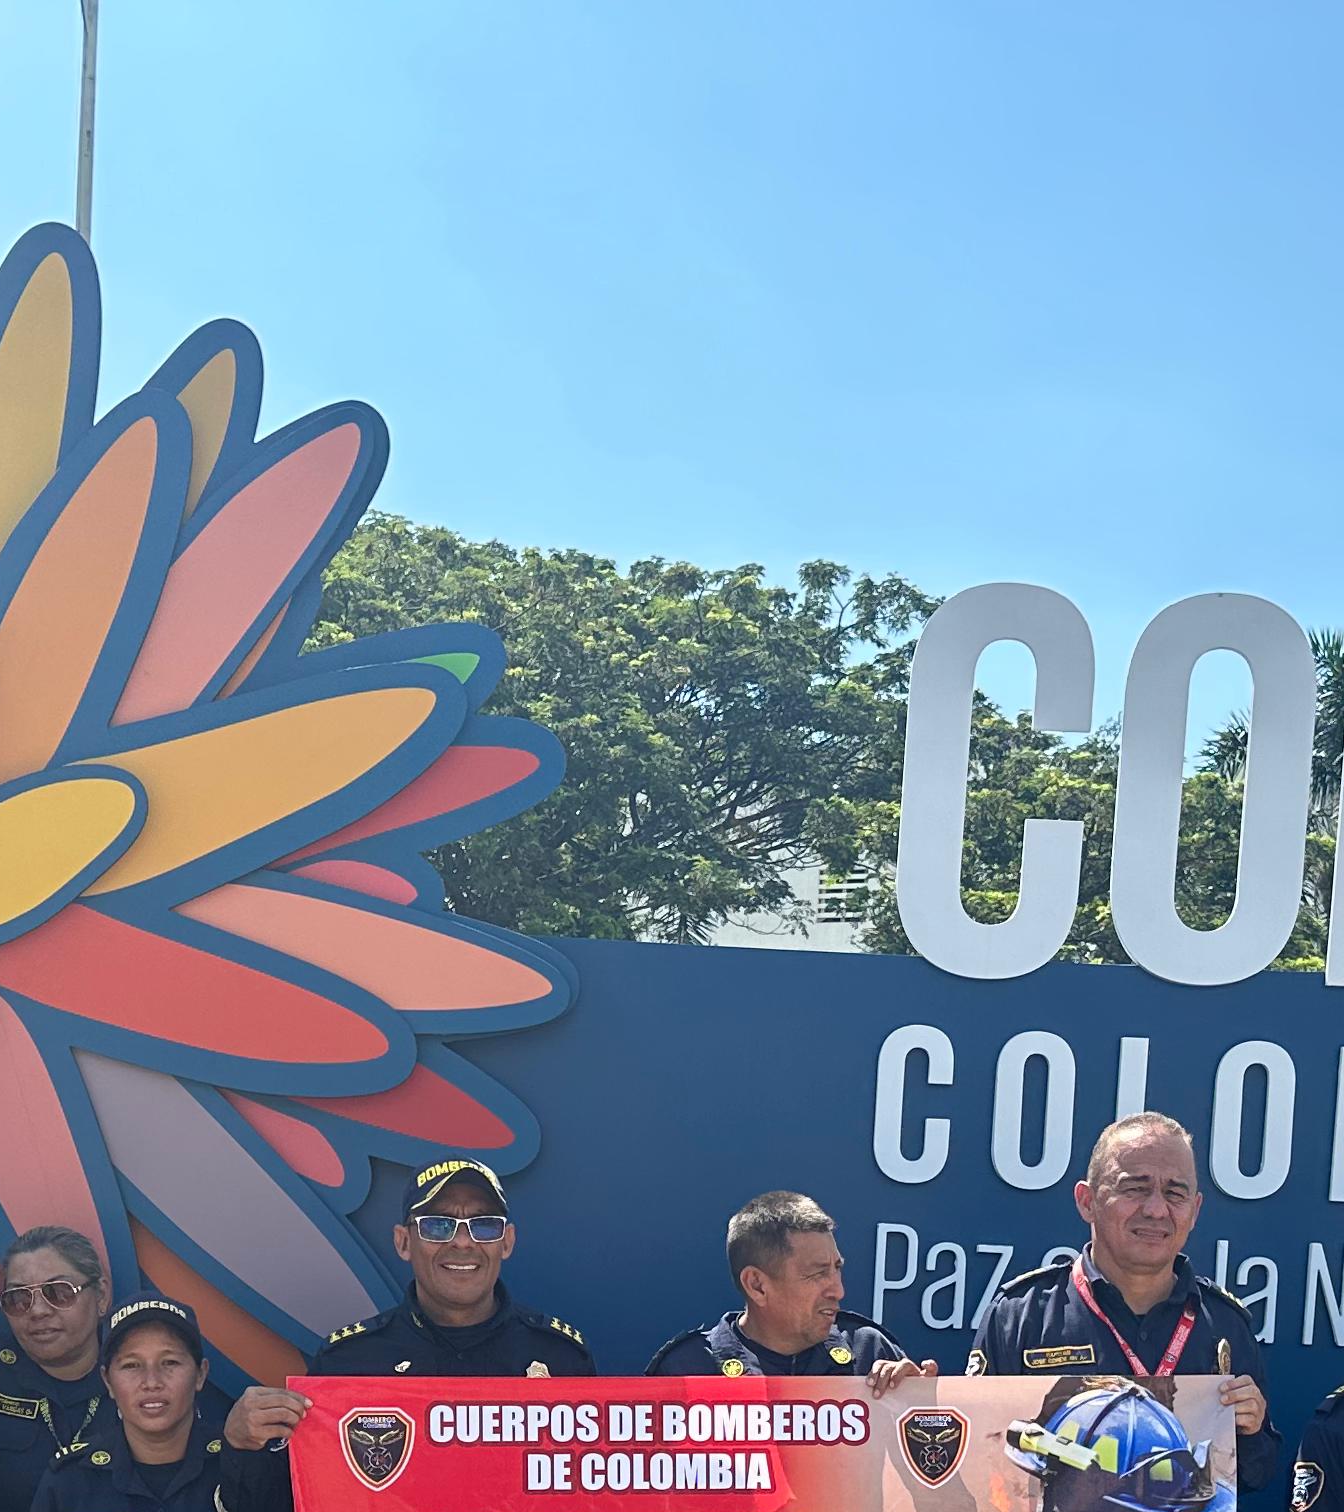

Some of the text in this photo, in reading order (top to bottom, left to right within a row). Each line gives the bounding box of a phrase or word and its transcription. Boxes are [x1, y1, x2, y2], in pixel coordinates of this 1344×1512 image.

[872, 1222, 1014, 1330] Paz
[429, 1403, 866, 1443] CUERPOS DE BOMBEROS
[527, 1452, 772, 1491] DE COLOMBIA
